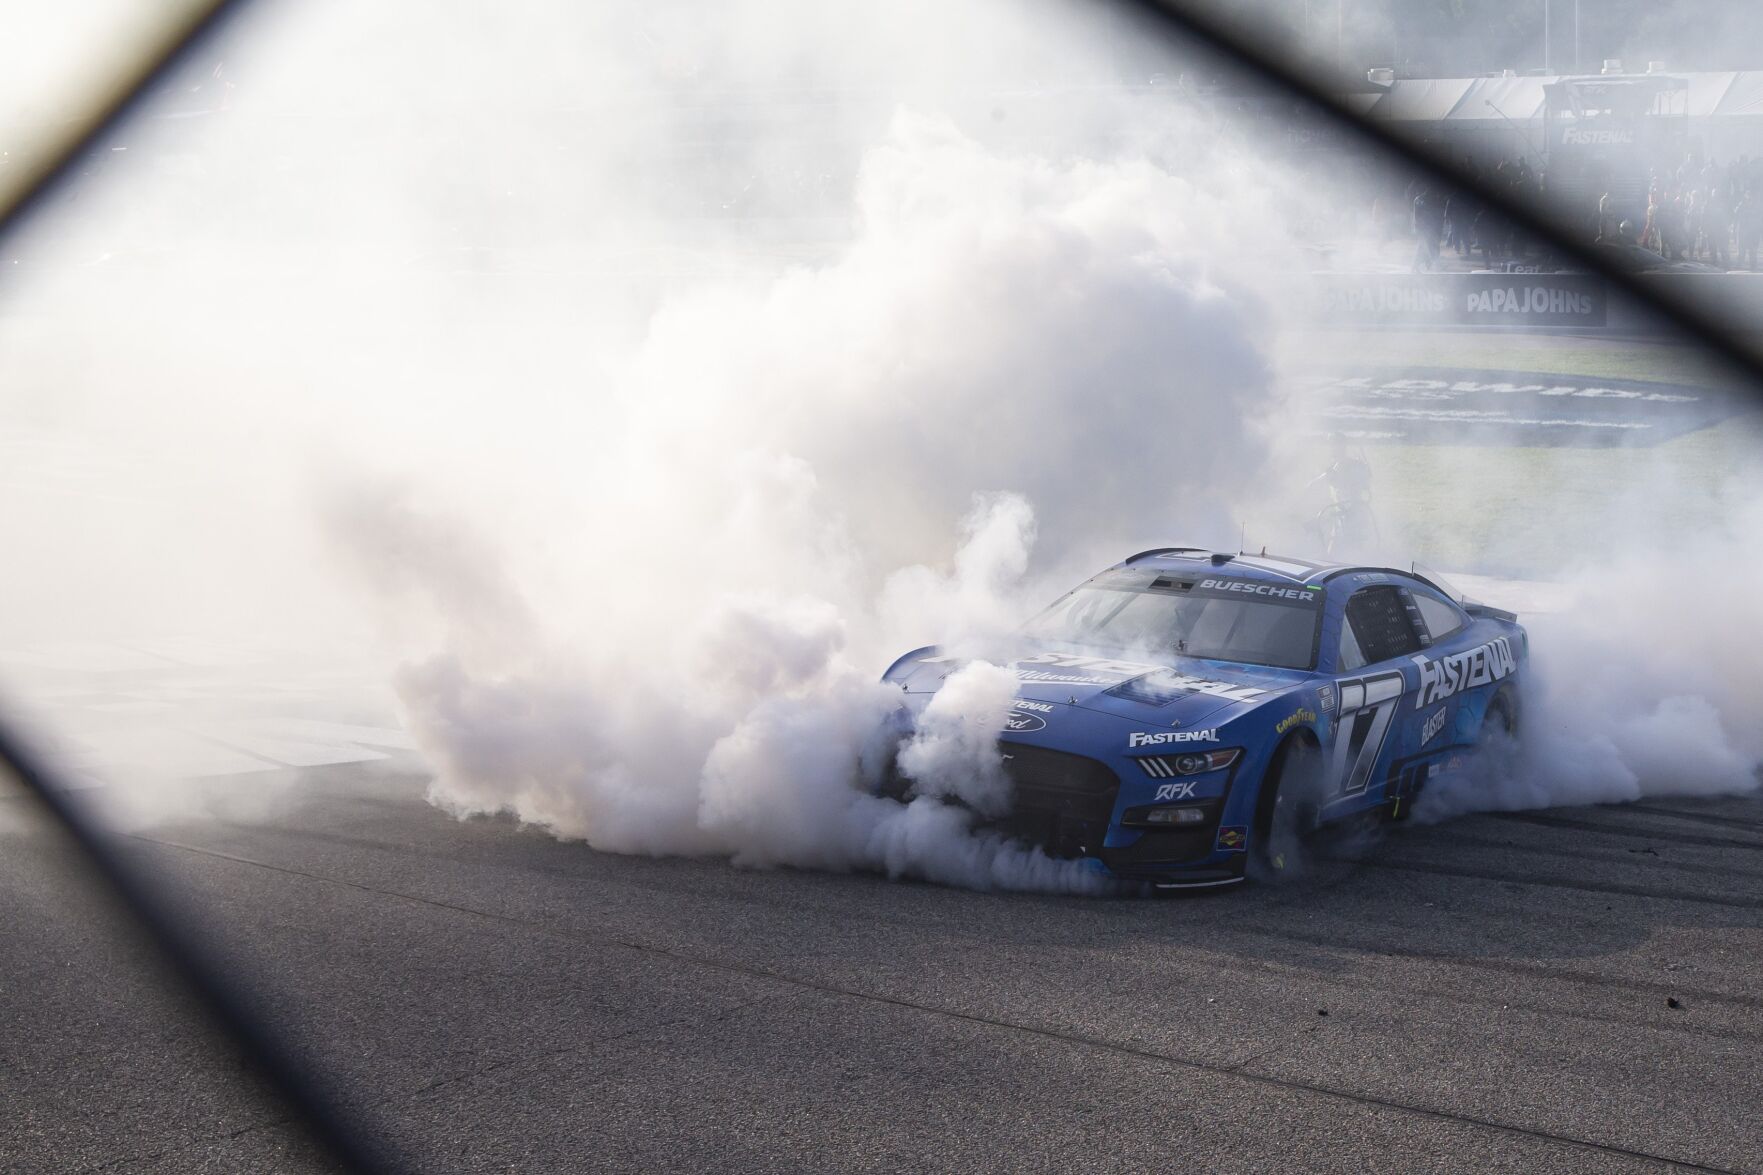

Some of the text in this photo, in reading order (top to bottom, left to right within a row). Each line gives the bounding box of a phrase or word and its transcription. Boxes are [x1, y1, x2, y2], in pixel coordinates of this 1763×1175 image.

[1199, 578, 1315, 601] BUESCHER
[1411, 636, 1517, 709] FASTENAL
[1129, 728, 1220, 748] FASTENAL
[1327, 669, 1405, 797] 17
[1154, 781, 1198, 800] RFK
